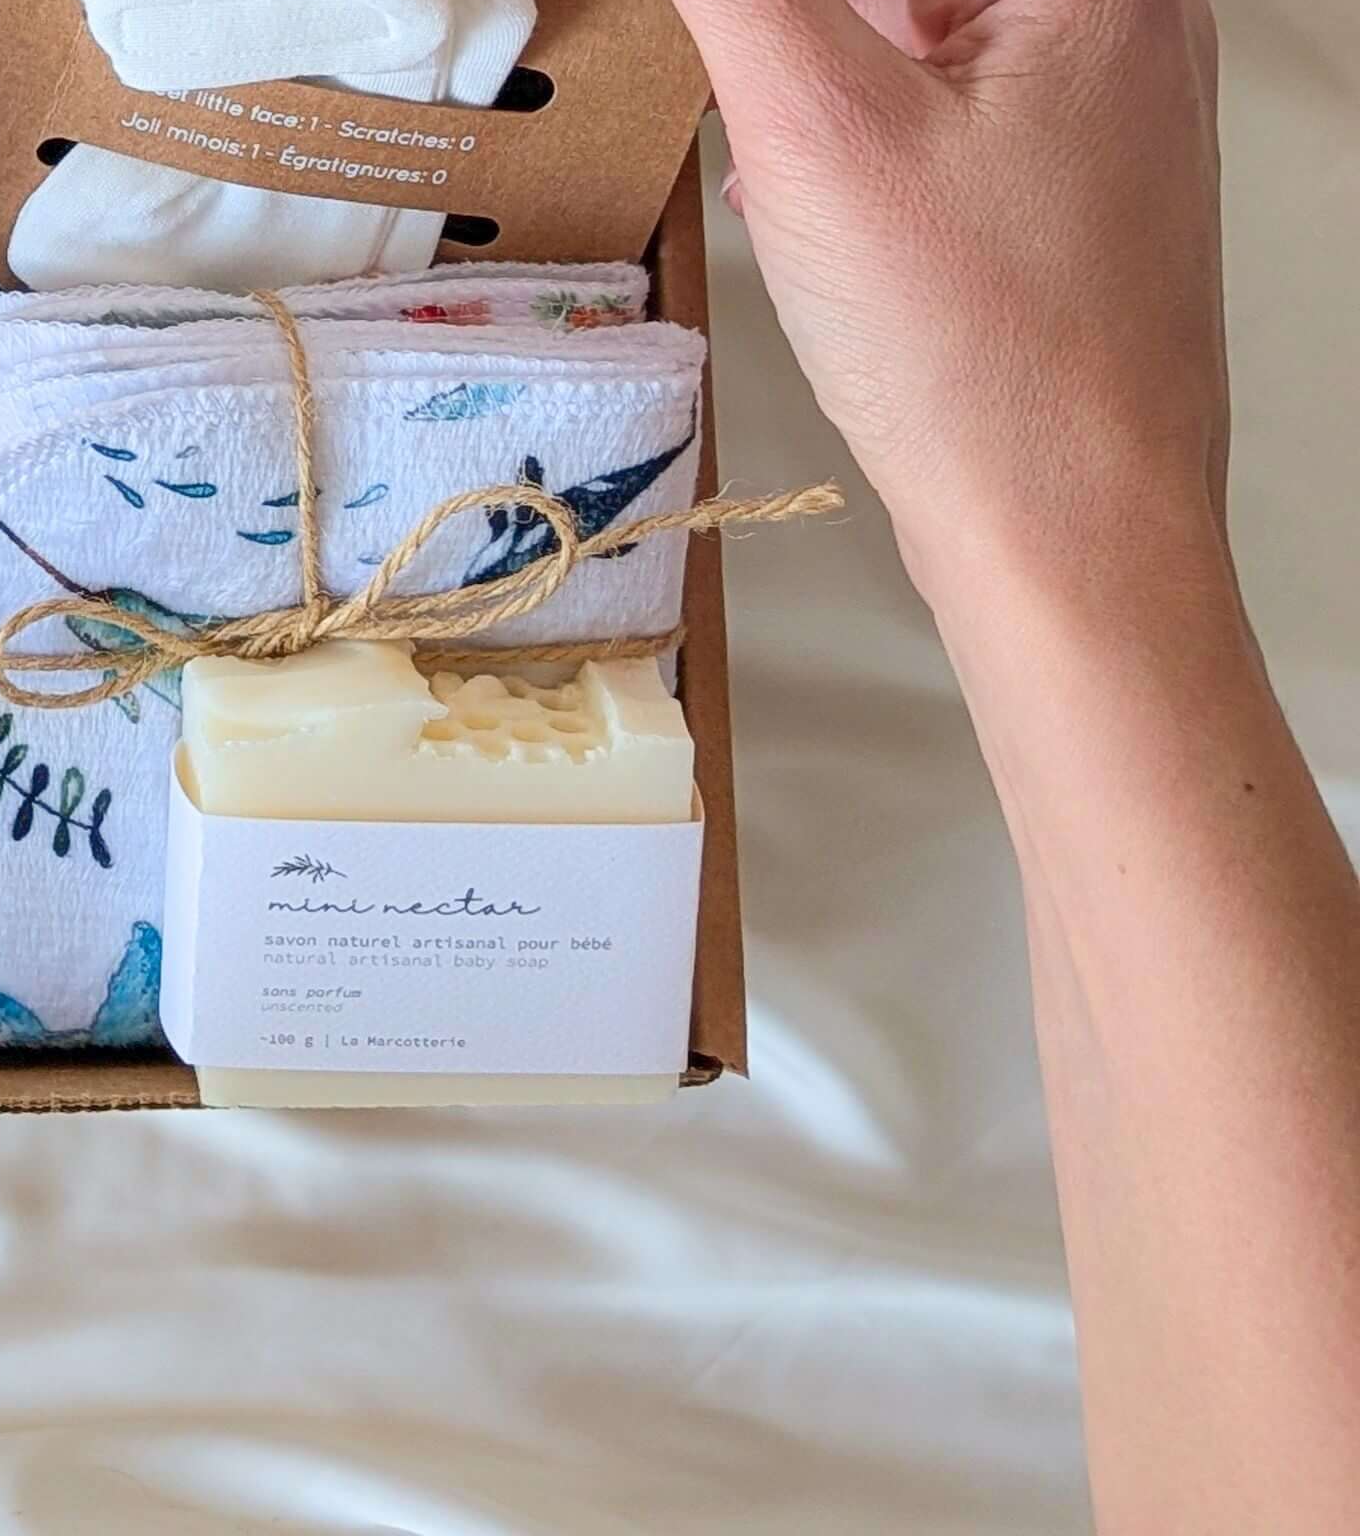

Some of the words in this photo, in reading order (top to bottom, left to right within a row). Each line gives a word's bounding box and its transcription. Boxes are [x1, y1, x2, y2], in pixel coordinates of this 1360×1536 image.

[195, 90, 244, 117] little
[251, 104, 306, 131] face:
[309, 116, 319, 132] 1
[337, 121, 457, 152] Scratches:
[121, 110, 161, 134] Joli
[165, 124, 247, 157] minois:
[249, 144, 261, 160] 1
[279, 145, 428, 186] Égratignures:
[267, 896, 376, 914] mini
[383, 887, 542, 916] nectar
[263, 934, 318, 948] savon
[327, 934, 401, 950] naturel
[411, 935, 507, 951] artisanal
[517, 939, 561, 953] pour
[570, 936, 613, 952] bébé
[263, 951, 337, 966] natural
[347, 952, 441, 968] artisanal
[452, 953, 495, 971] baby
[505, 955, 550, 971] soap
[260, 986, 298, 998] sans
[304, 986, 363, 1000] parfum
[260, 1001, 344, 1014] unscented
[304, 1034, 314, 1049] g
[340, 1035, 360, 1048] La
[366, 1034, 467, 1049] Marcotterie
